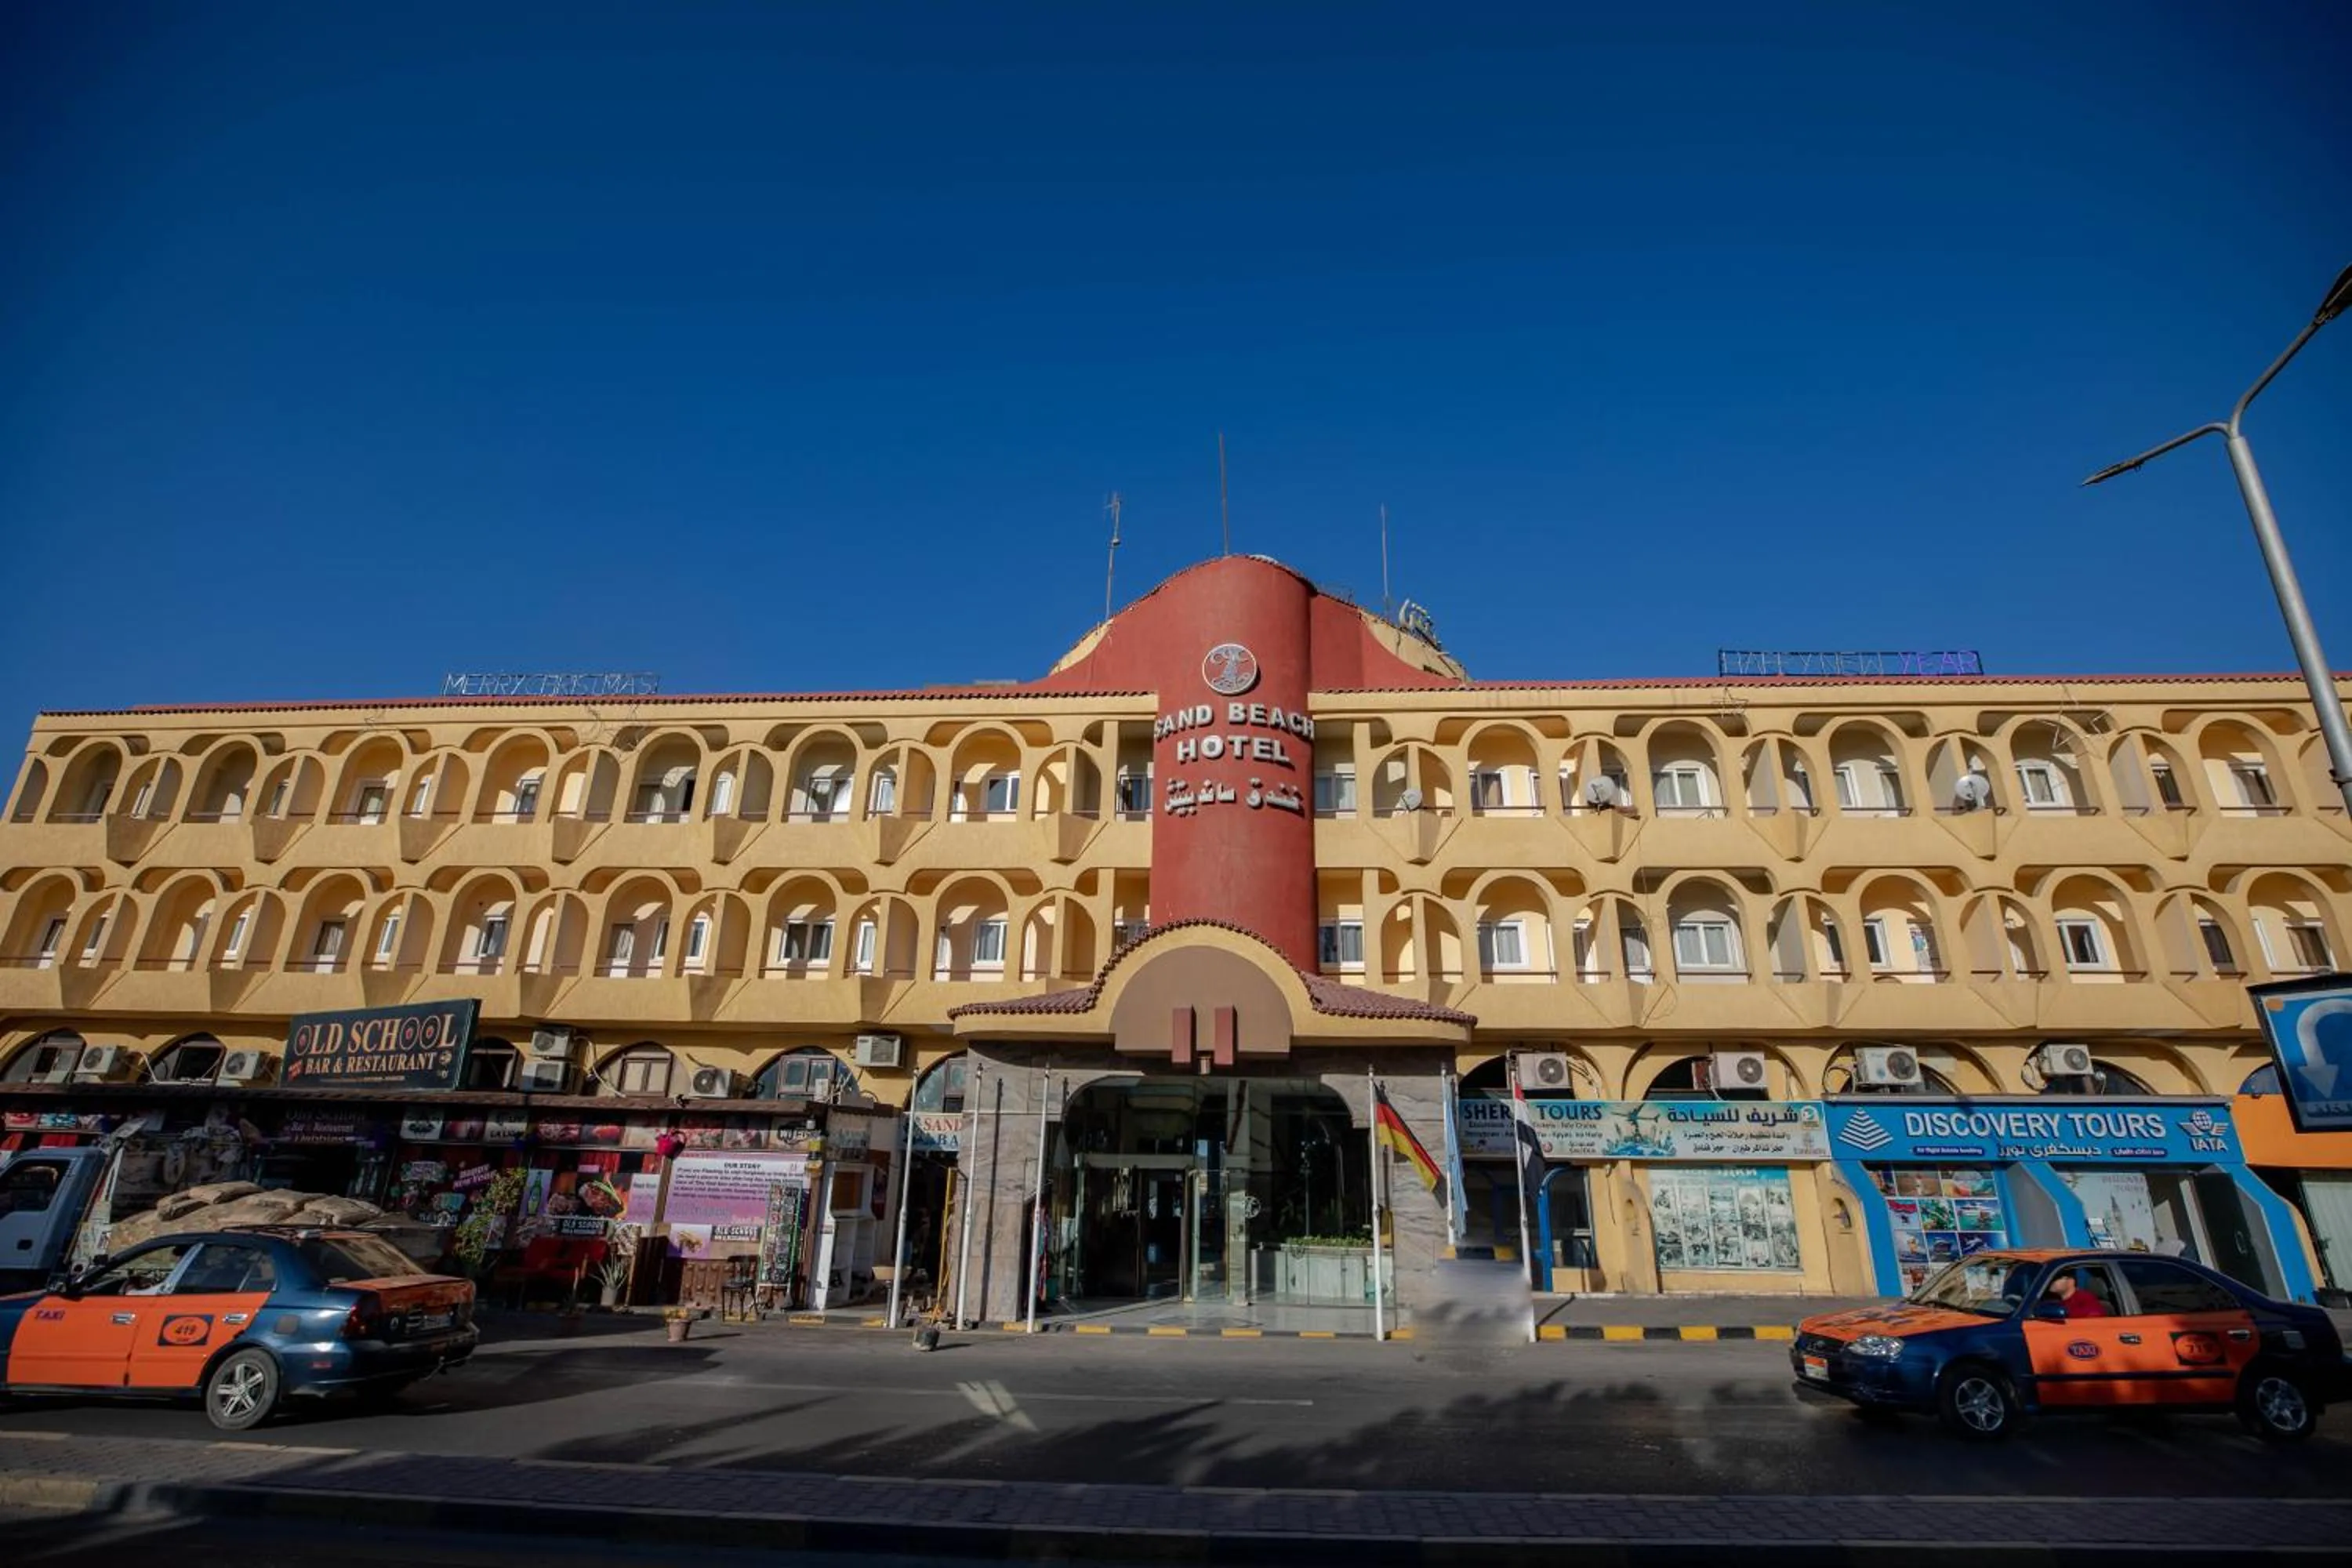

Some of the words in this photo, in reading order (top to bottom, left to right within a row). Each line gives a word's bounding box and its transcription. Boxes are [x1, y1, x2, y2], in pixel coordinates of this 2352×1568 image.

[1899, 652, 1980, 676] YEAR
[443, 673, 526, 695] MERRY
[1154, 704, 1213, 739] SAND
[1229, 702, 1315, 739] BEACH
[1178, 735, 1290, 762] HOTEL
[1247, 778, 1302, 811] فندق
[293, 1023, 343, 1056] OLD
[347, 1014, 457, 1053] SCHOOL
[305, 1058, 331, 1075] BAR
[333, 1056, 343, 1073] &
[346, 1051, 437, 1073] RESTAURANT
[1536, 1105, 1602, 1120] TOURS
[1668, 1107, 1740, 1127] للسياحة
[1746, 1105, 1798, 1127] شريف
[924, 1117, 961, 1131] SAND
[1904, 1111, 2060, 1138] DISCOVERY
[2067, 1112, 2167, 1138] TOURS
[938, 1134, 959, 1147] BA
[2191, 1137, 2229, 1152] IATA
[34, 1309, 66, 1321] TAXI
[2072, 1343, 2097, 1356] TAXI
